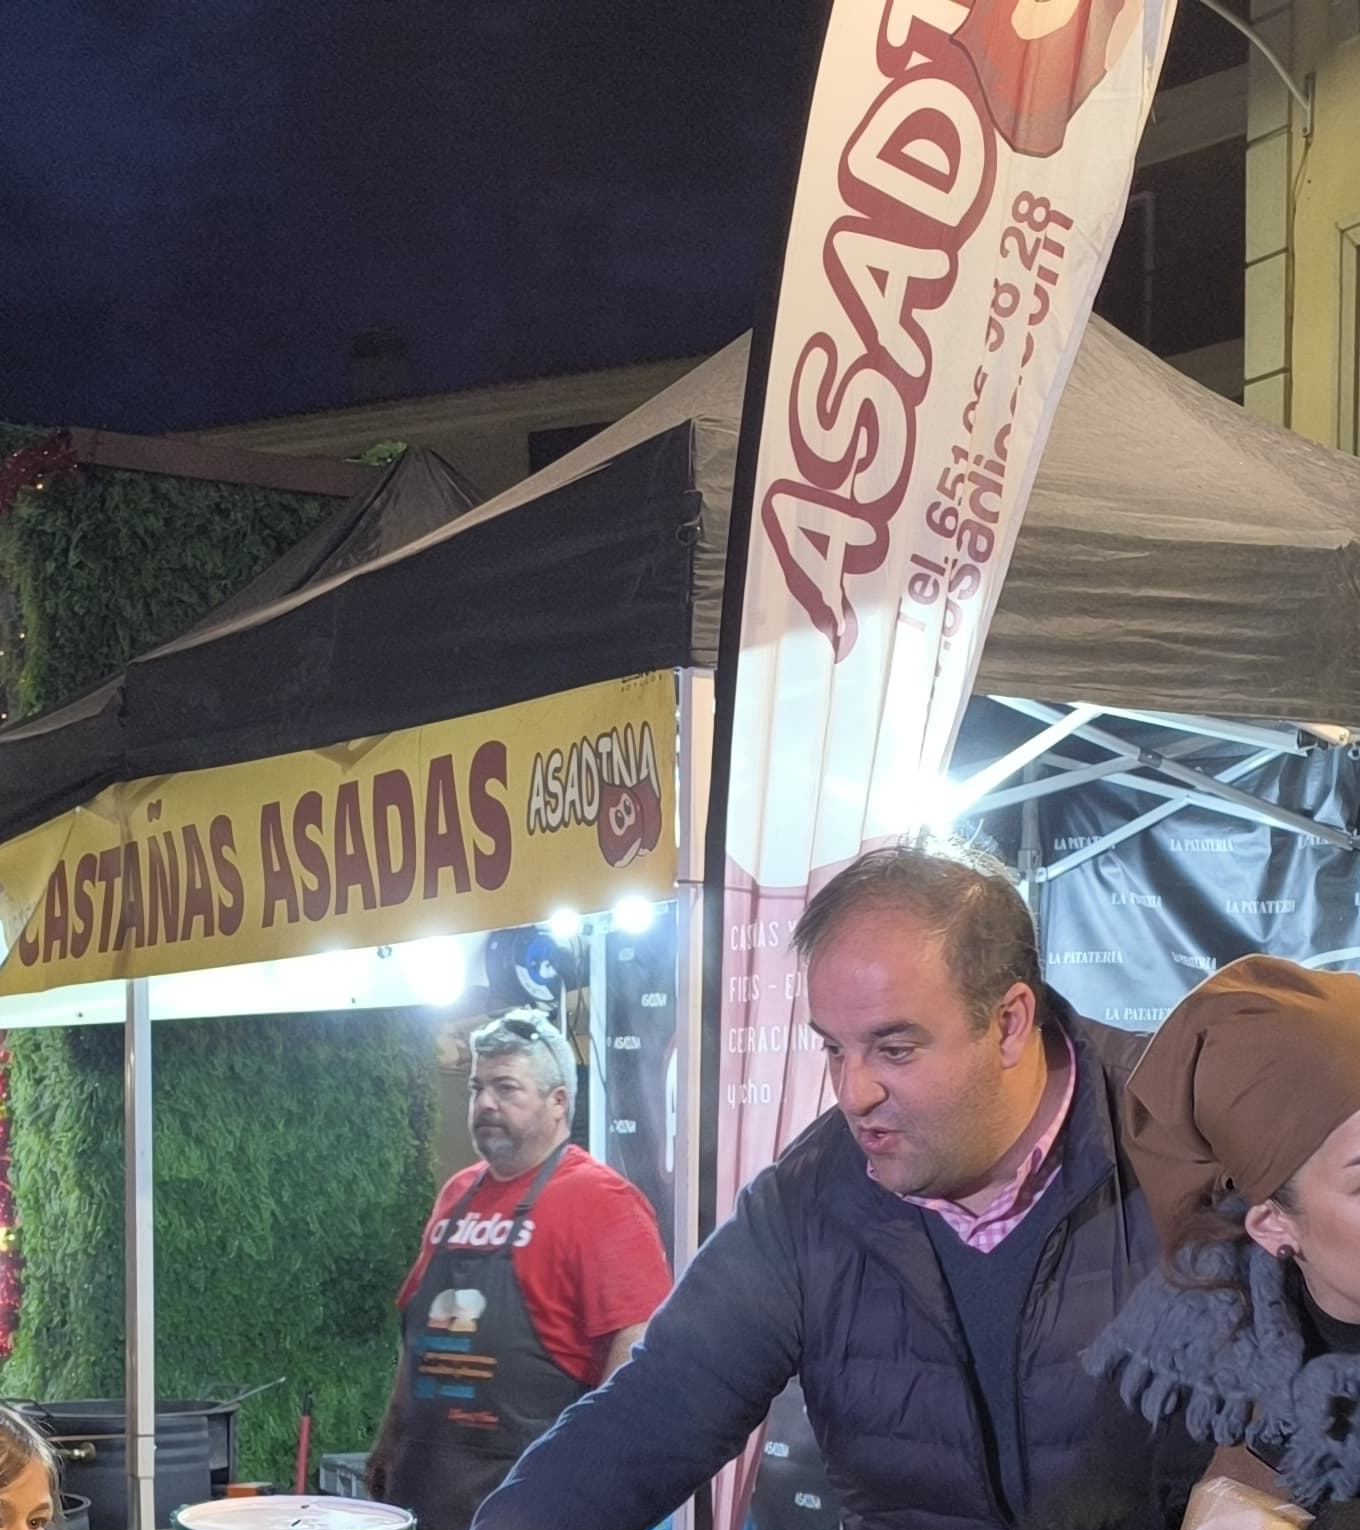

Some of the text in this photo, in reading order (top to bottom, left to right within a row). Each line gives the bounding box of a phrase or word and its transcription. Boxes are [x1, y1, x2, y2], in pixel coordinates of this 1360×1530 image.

[1000, 190, 1051, 271] 28
[260, 740, 513, 928] ASADAS
[1184, 838, 1234, 851] PATATERIA
[1049, 951, 1124, 965] LA PATATERIA
[1105, 1008, 1120, 1021] LA
